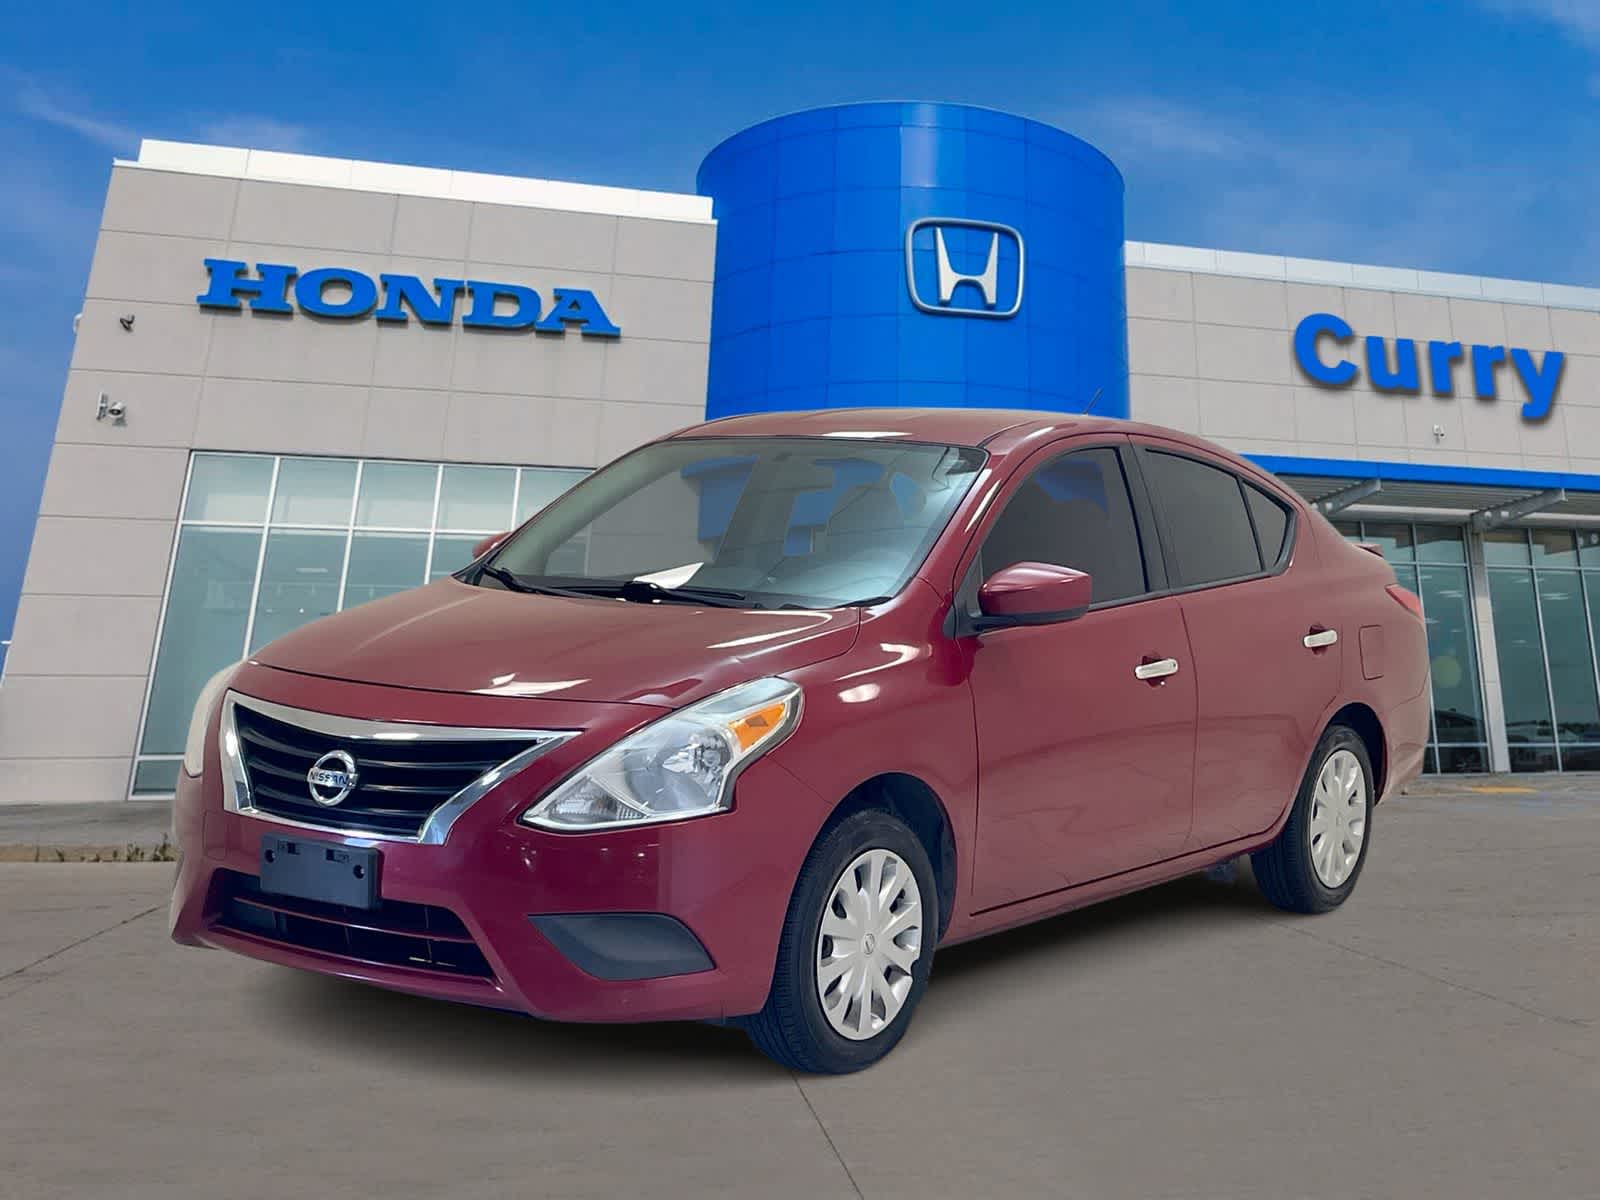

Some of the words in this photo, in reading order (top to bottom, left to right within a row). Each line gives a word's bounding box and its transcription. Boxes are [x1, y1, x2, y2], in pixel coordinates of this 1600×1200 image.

[197, 258, 621, 337] HONDA
[1294, 313, 1565, 418] Curry
[309, 770, 347, 785] NISSAN
